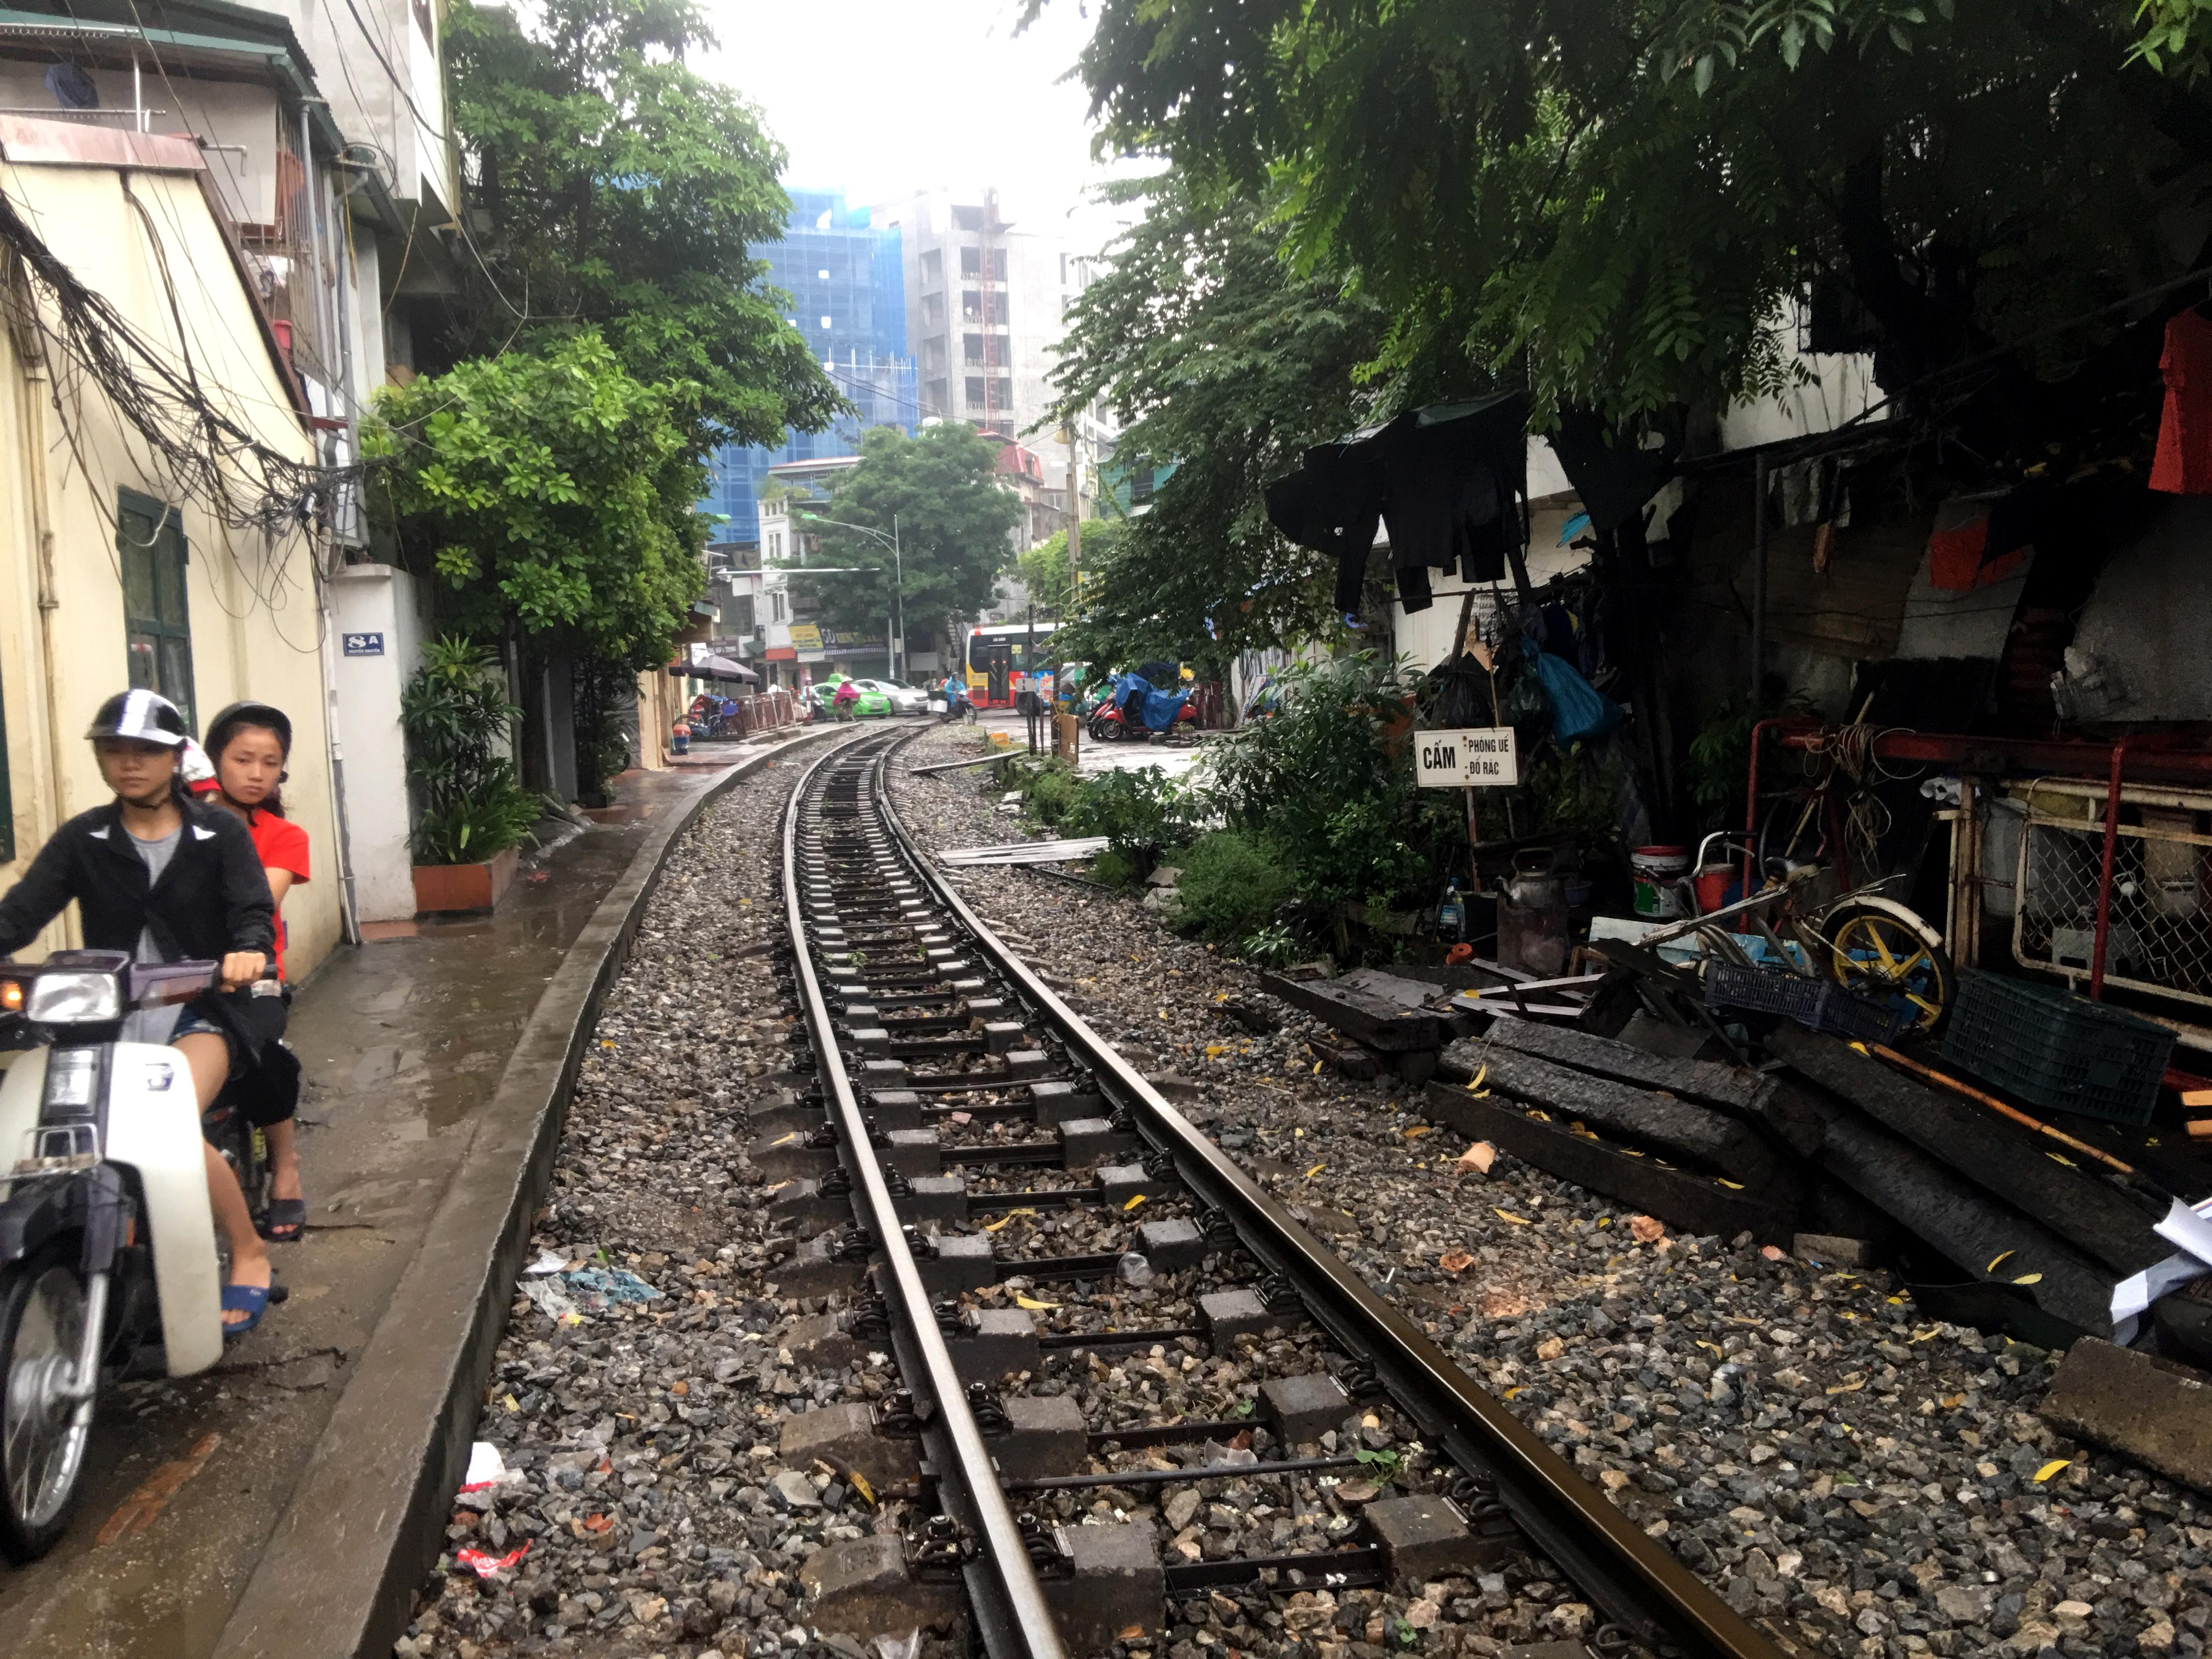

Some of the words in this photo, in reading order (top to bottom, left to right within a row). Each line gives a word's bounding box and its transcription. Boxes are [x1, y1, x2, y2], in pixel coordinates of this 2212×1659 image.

[1469, 736, 1497, 753] PHÓNG
[1498, 733, 1509, 753] UẾ
[1423, 739, 1456, 770] CẤM
[1469, 755, 1481, 775] ĐỔ
[1483, 758, 1499, 775] RÁC
